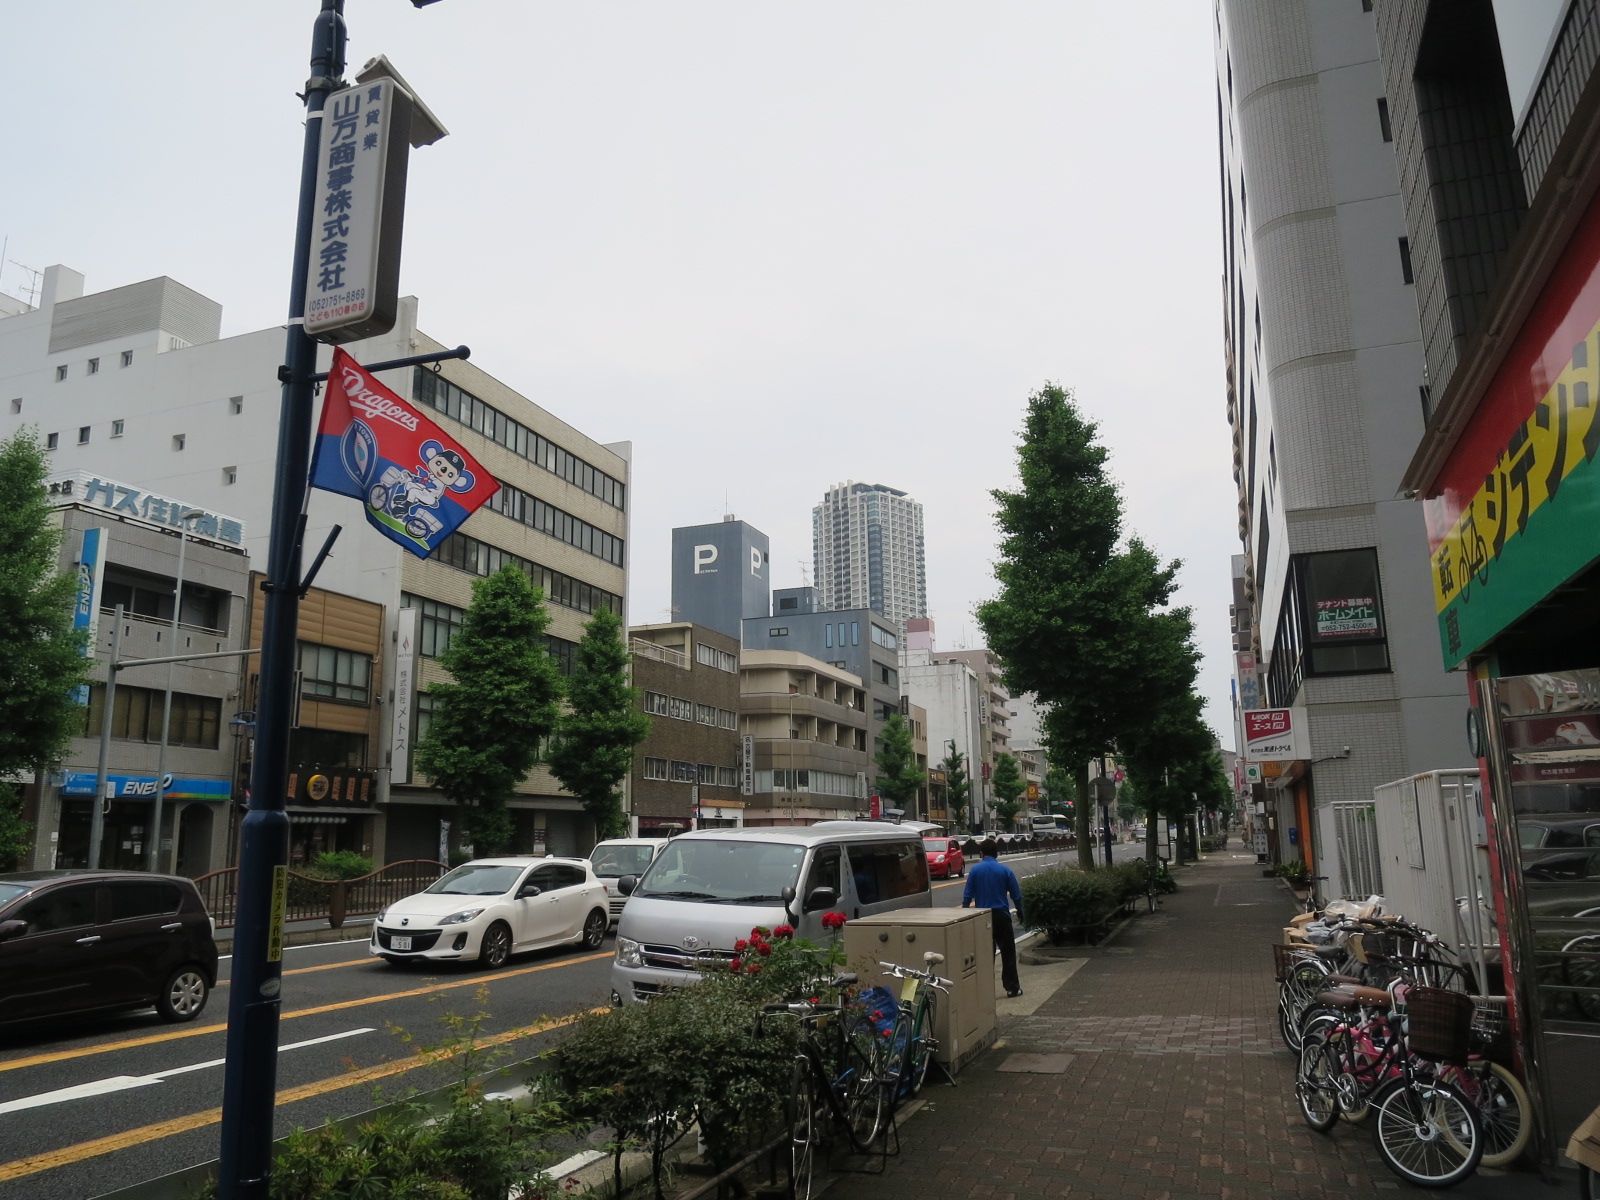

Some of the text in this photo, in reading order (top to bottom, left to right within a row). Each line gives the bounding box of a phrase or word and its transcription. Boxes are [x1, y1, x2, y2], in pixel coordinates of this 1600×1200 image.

[316, 95, 361, 292] 山万商事株式会社
[309, 288, 366, 312] (052)751-8869
[342, 366, 420, 431] Dragons
[694, 544, 719, 575] P
[750, 545, 762, 576] P
[1318, 606, 1373, 620] ホームメイト
[396, 670, 408, 750] 株式会社メトス
